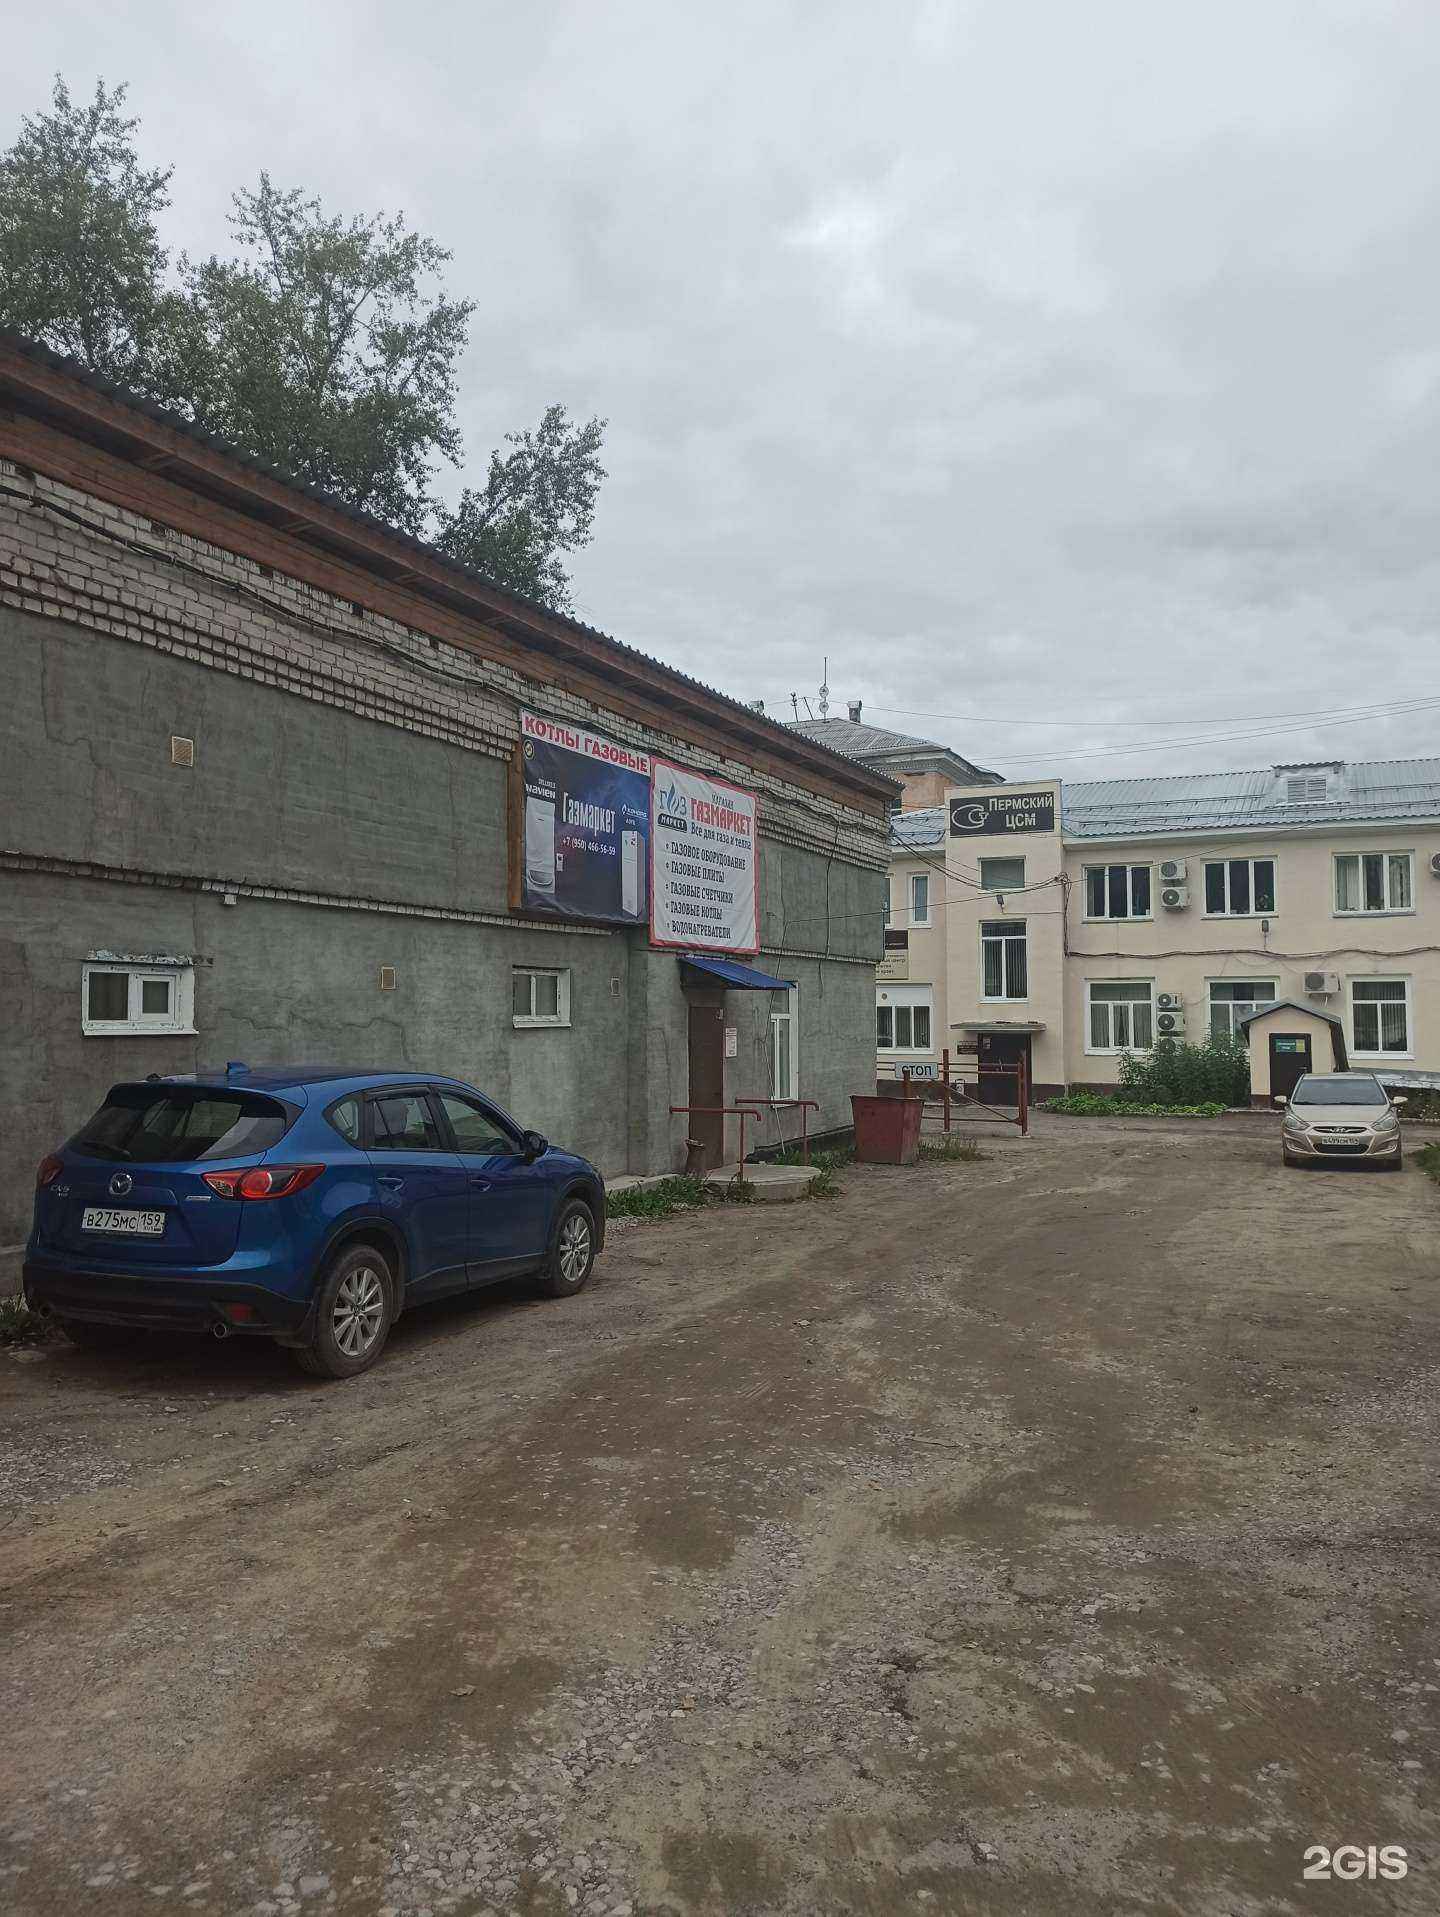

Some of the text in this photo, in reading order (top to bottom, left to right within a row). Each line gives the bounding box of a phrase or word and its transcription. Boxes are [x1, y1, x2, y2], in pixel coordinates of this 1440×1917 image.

[525, 716, 648, 773] КОТЛЫ ГАЗОВЫЕ
[562, 791, 616, 837] Газмаркет
[690, 798, 752, 836] ГАЗМАРКЕТ
[1005, 812, 1036, 830] ЦСМ
[563, 836, 571, 846] +7
[691, 822, 703, 837] Все
[703, 829, 715, 841] для
[716, 832, 730, 845] газа
[671, 841, 746, 871] ГАЗОВОЕ ОБОРУДОВАНИЕ
[671, 860, 725, 883] ГАЗОВЫЕ ПЛИТЫ
[670, 881, 734, 904] ГАЗОВЫЕ СЧЕТЧИКИ
[670, 900, 723, 920] ГАЗОВЫЕ КОТЛЫ
[671, 920, 731, 939] ВОДОНАГРЕВАТЕЛИ
[140, 1212, 161, 1227] 159
